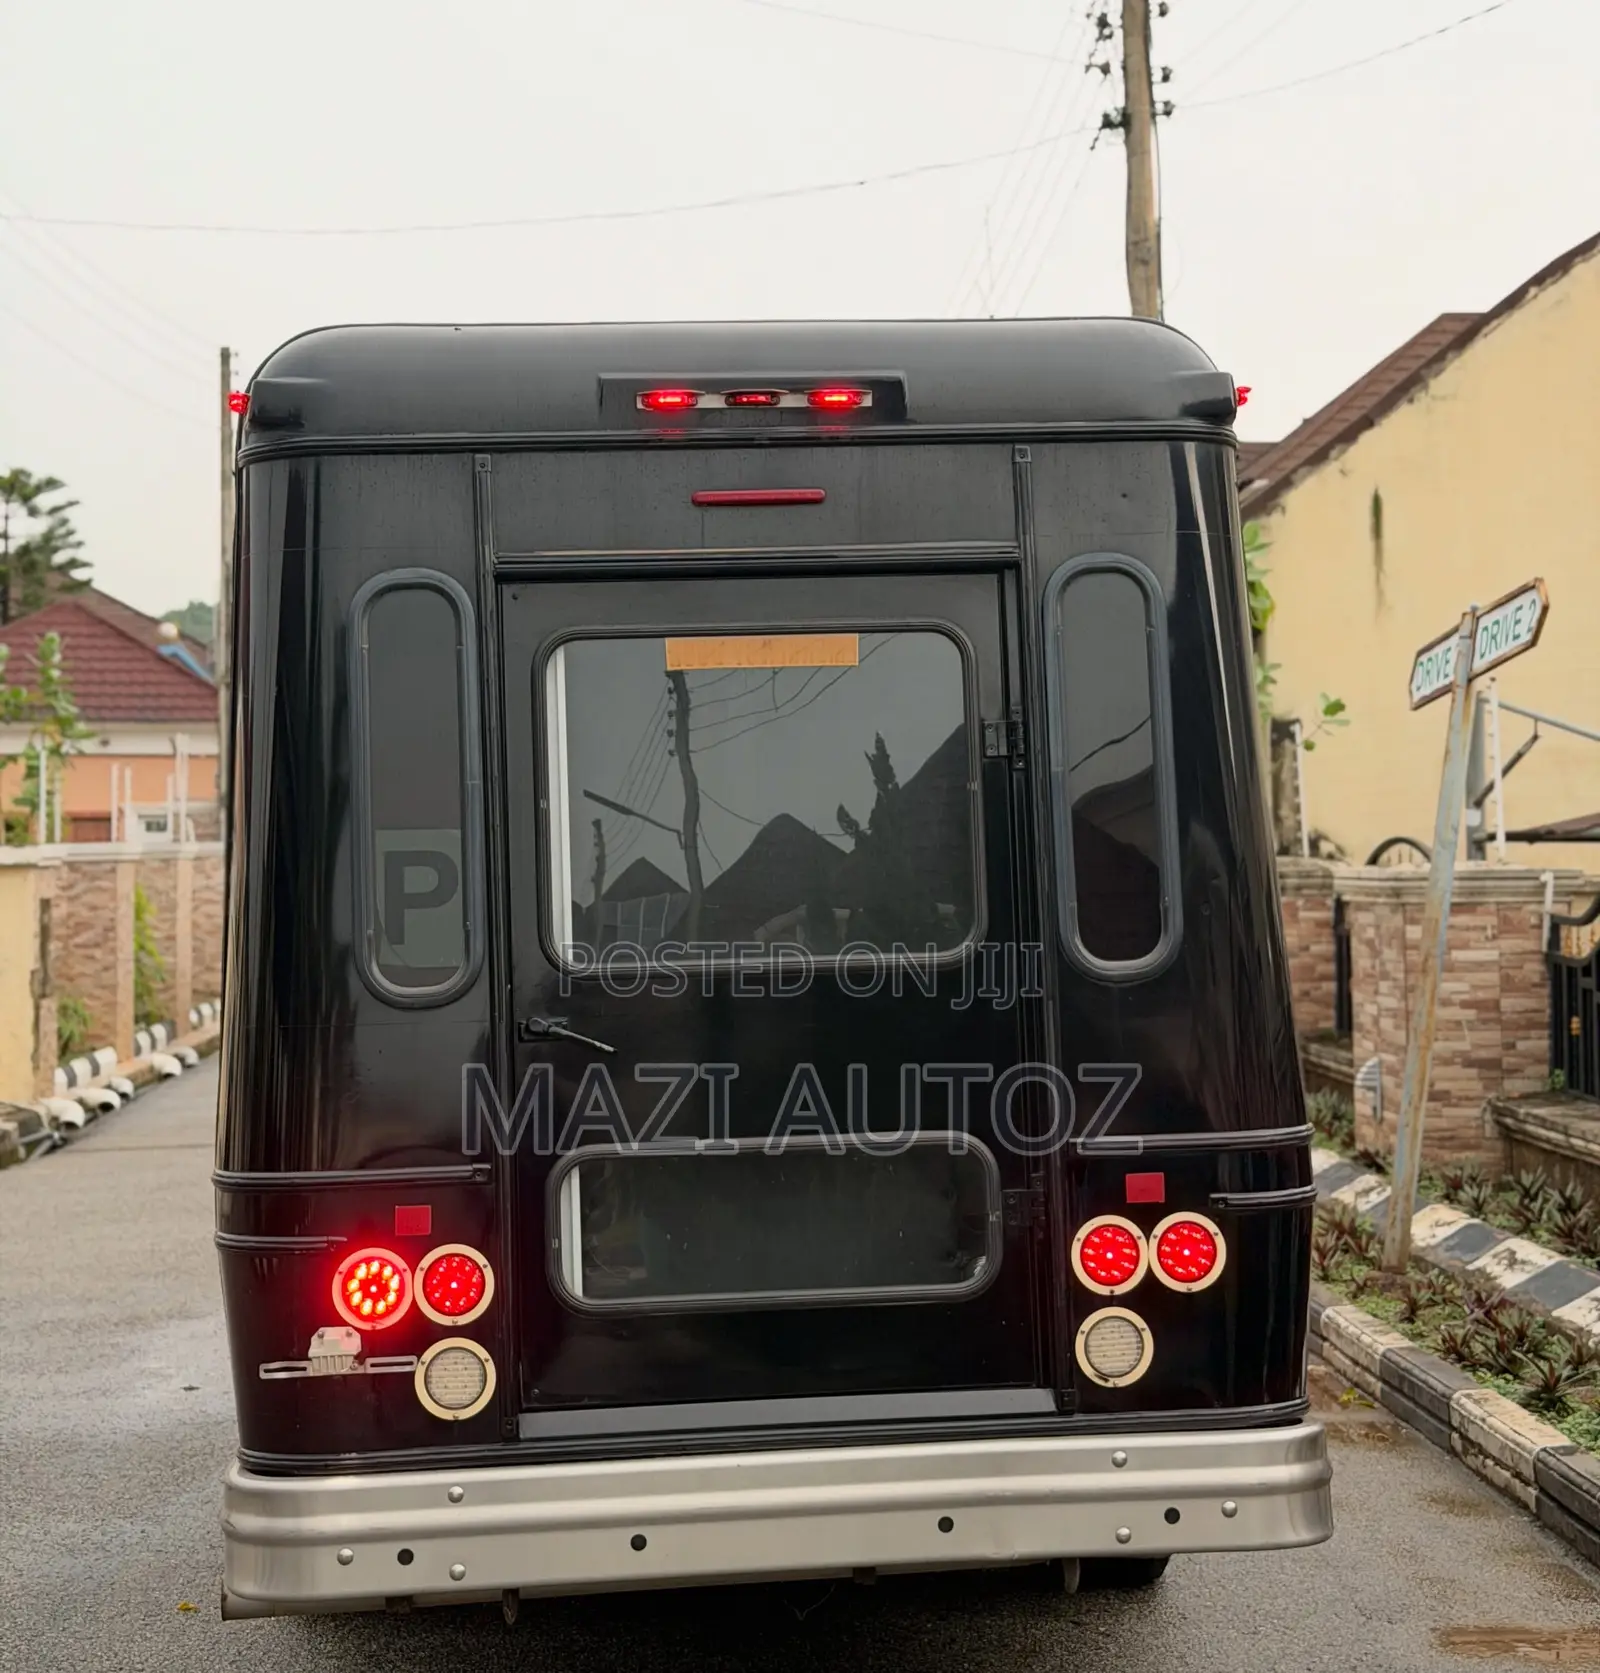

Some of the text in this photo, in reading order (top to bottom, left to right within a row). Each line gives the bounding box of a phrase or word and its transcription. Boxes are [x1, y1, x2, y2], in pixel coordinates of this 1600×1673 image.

[1479, 598, 1537, 660] DRIVE 2
[1415, 646, 1452, 692] DRIVE
[384, 850, 459, 945] P
